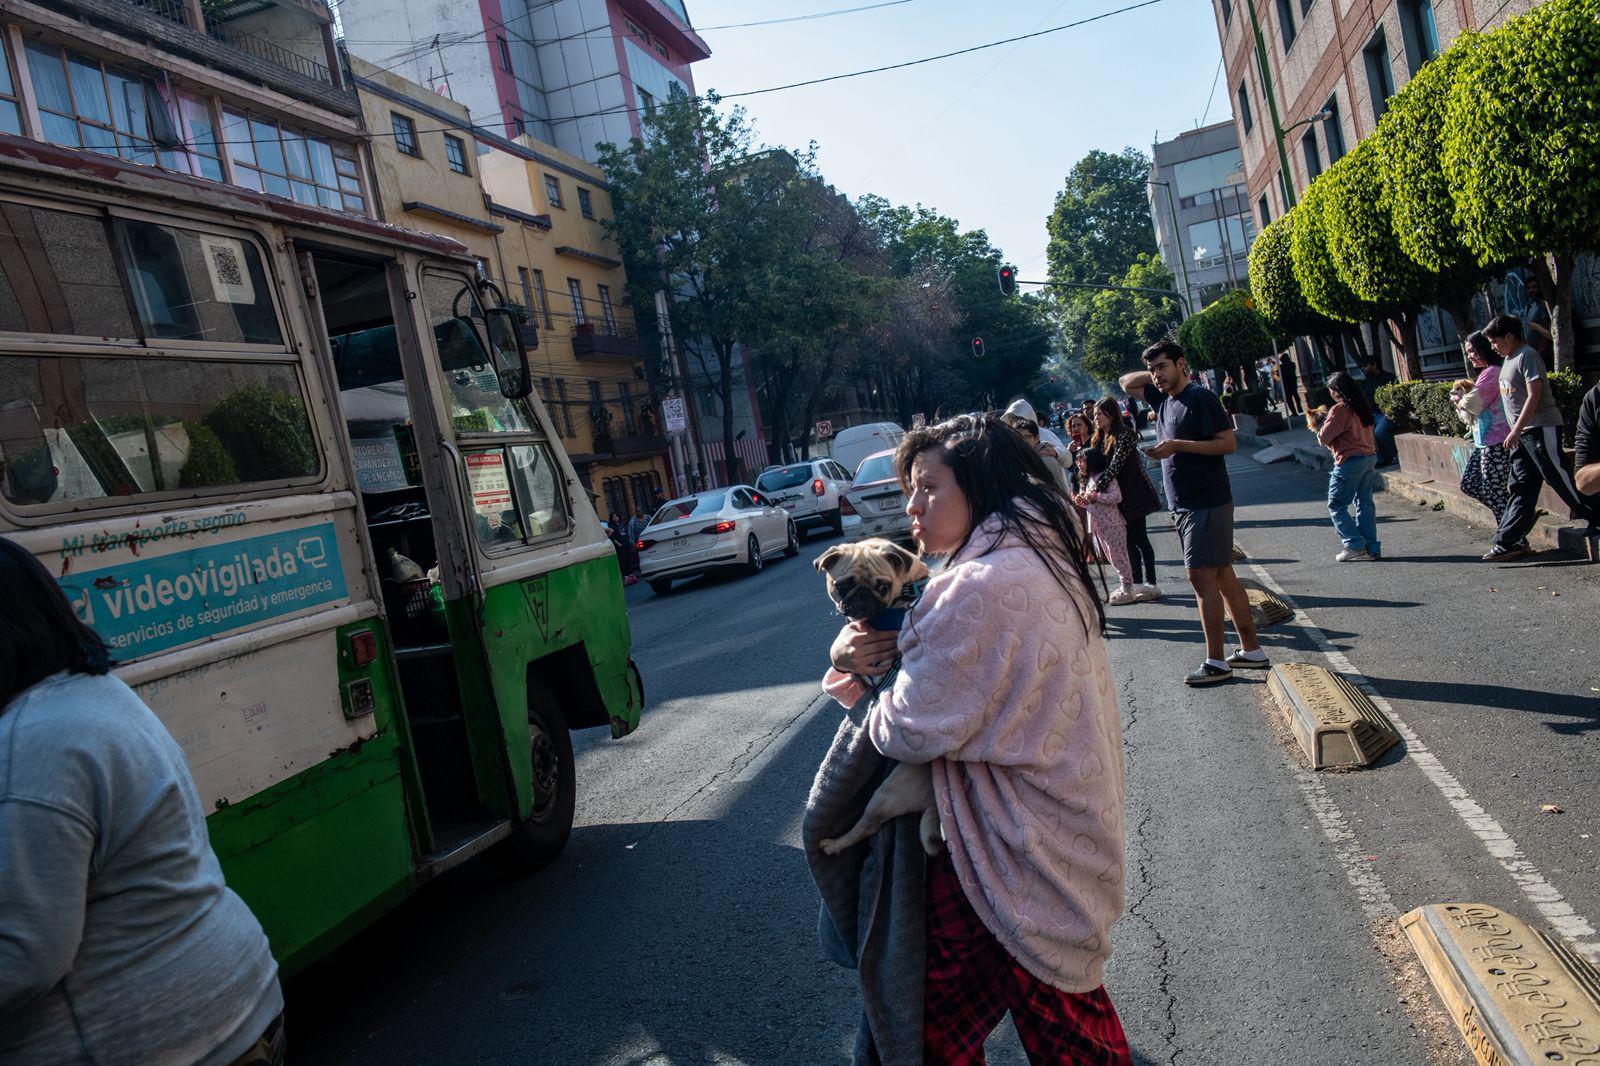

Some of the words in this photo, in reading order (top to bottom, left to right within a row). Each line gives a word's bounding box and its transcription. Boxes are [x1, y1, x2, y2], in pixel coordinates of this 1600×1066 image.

[60, 534, 85, 559] Mi
[91, 517, 188, 554] transporte
[192, 511, 247, 535] seguro
[102, 546, 298, 619] videovigilada
[110, 621, 173, 648] servicios
[177, 613, 194, 631] de
[197, 596, 260, 624] seguridad
[260, 595, 269, 611] y
[271, 577, 334, 605] emergencia
